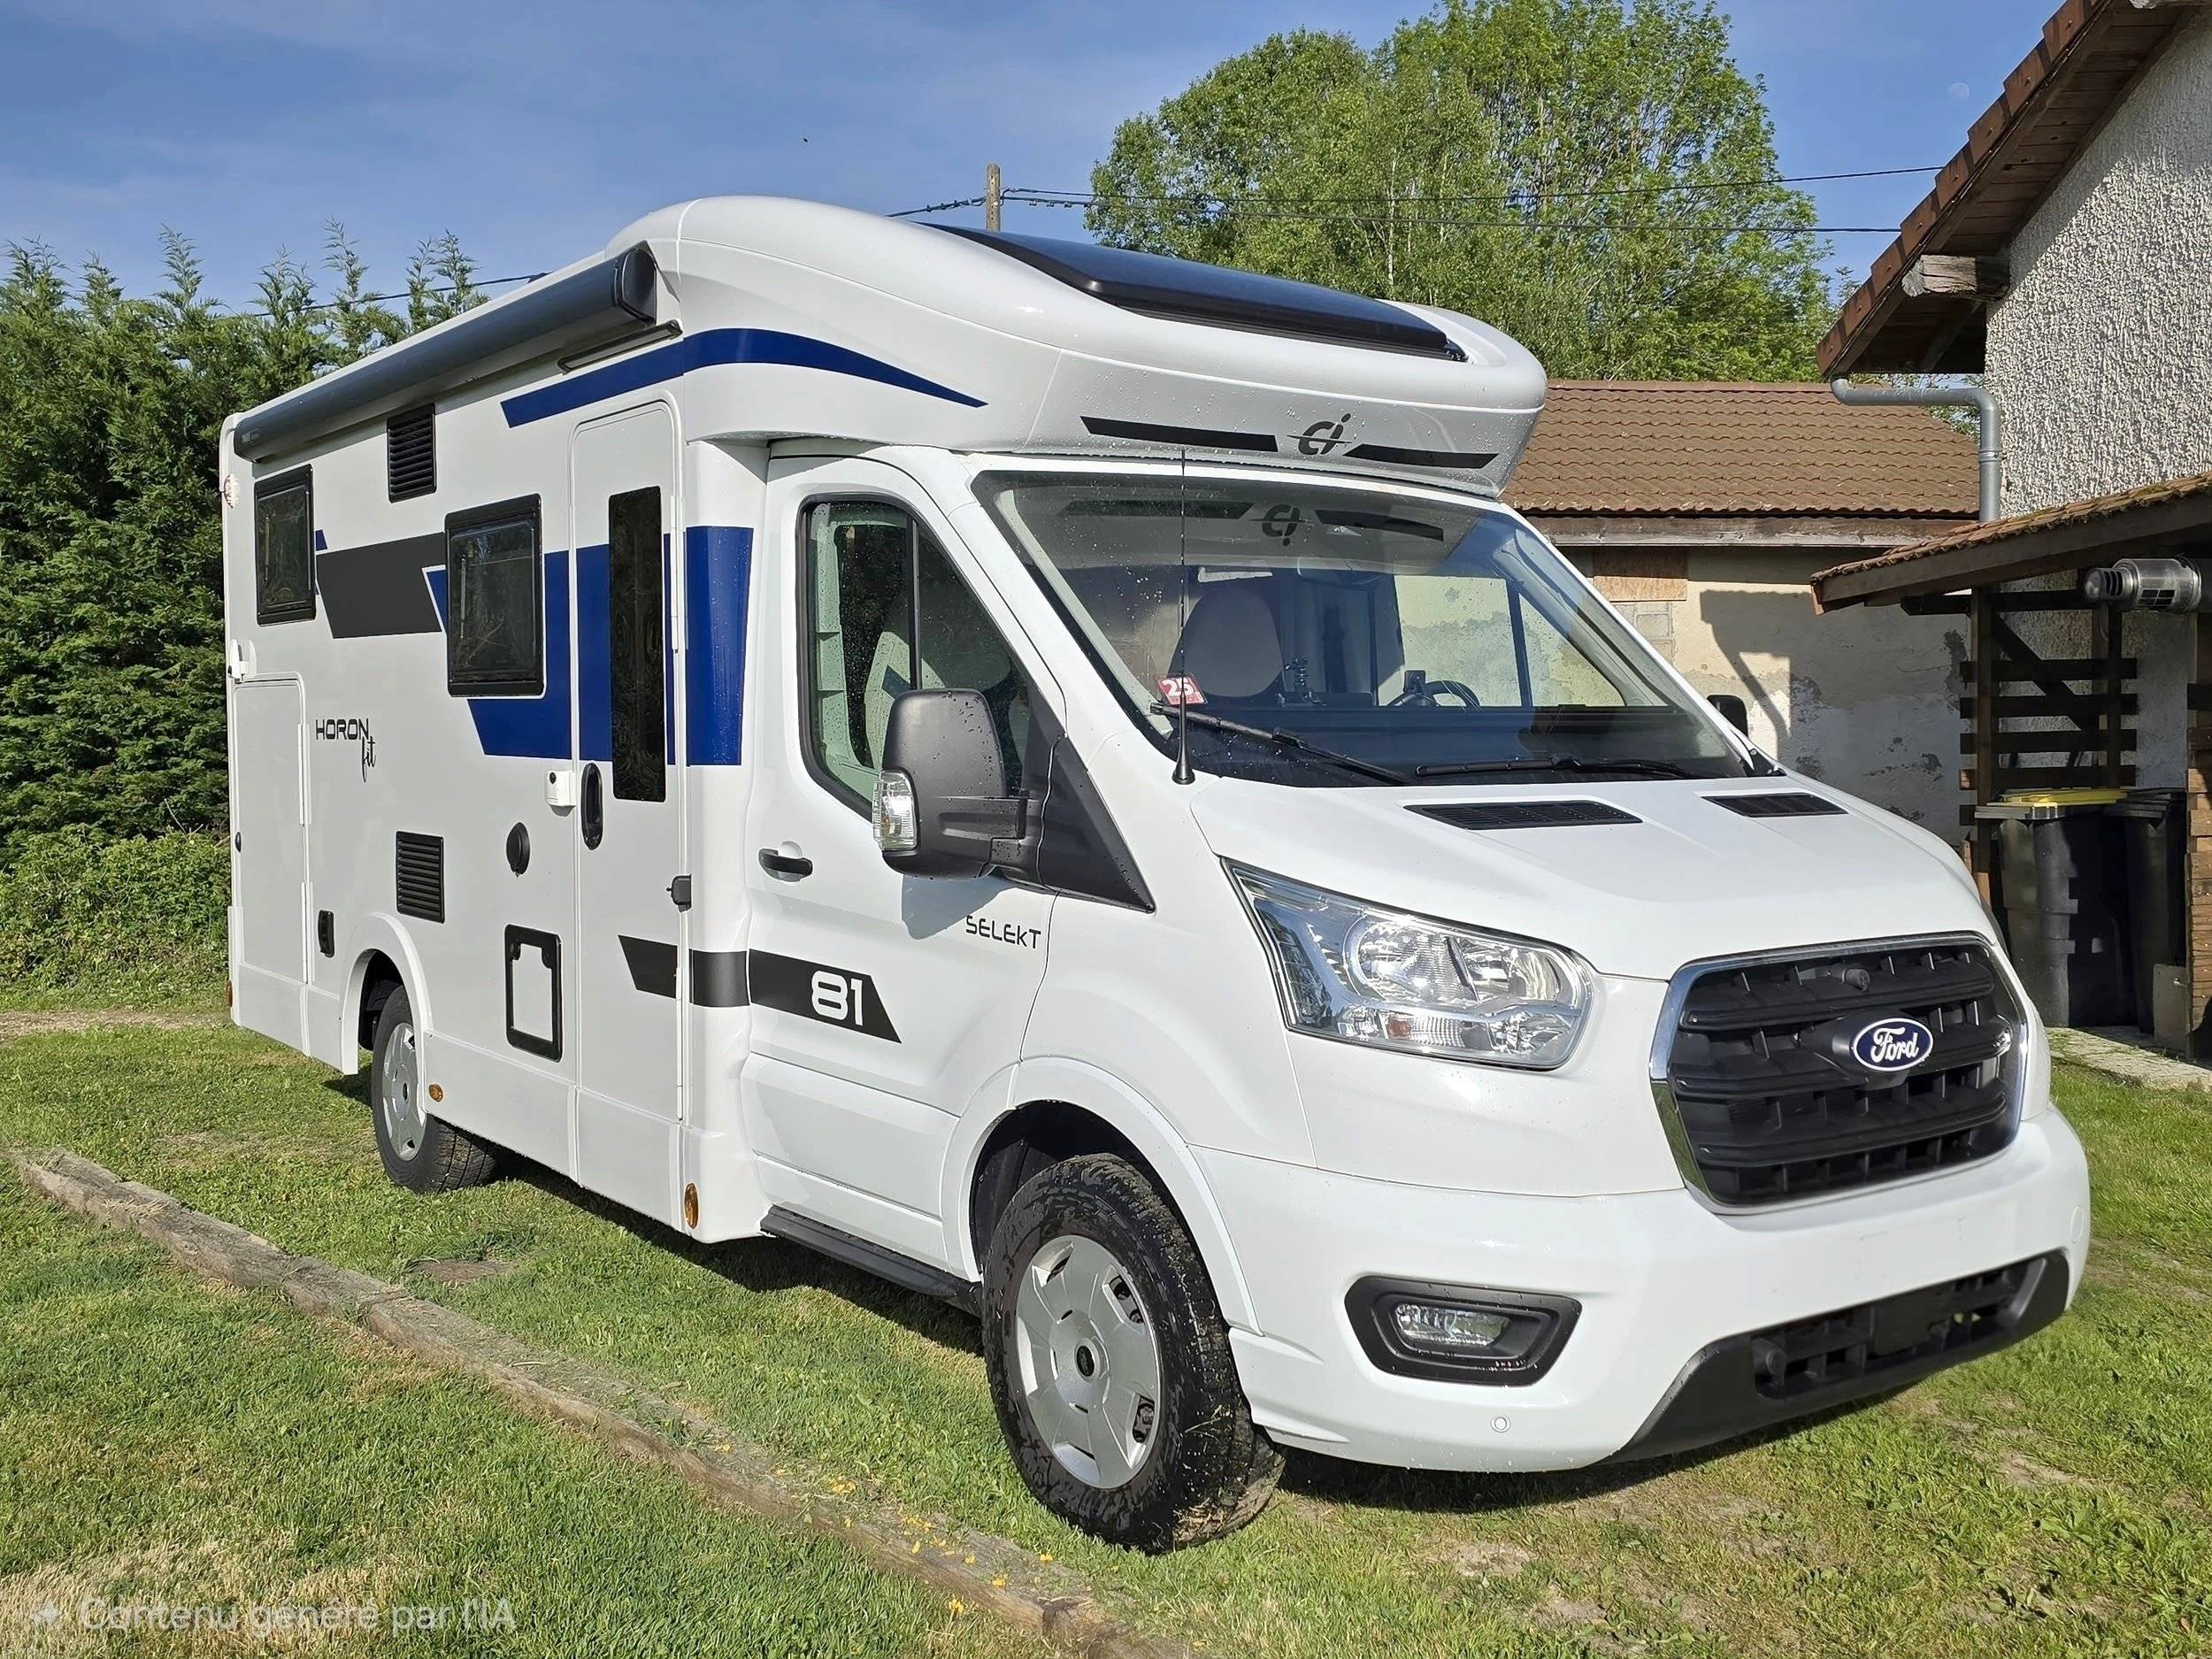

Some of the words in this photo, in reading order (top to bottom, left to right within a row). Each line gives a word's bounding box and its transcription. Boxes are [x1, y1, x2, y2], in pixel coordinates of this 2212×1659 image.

[1161, 676, 1194, 696] 25
[315, 718, 369, 740] HORON
[361, 735, 377, 783] fit
[965, 914, 1041, 949] SELEKT
[811, 970, 864, 1026] 81
[1870, 1026, 1920, 1063] Ford
